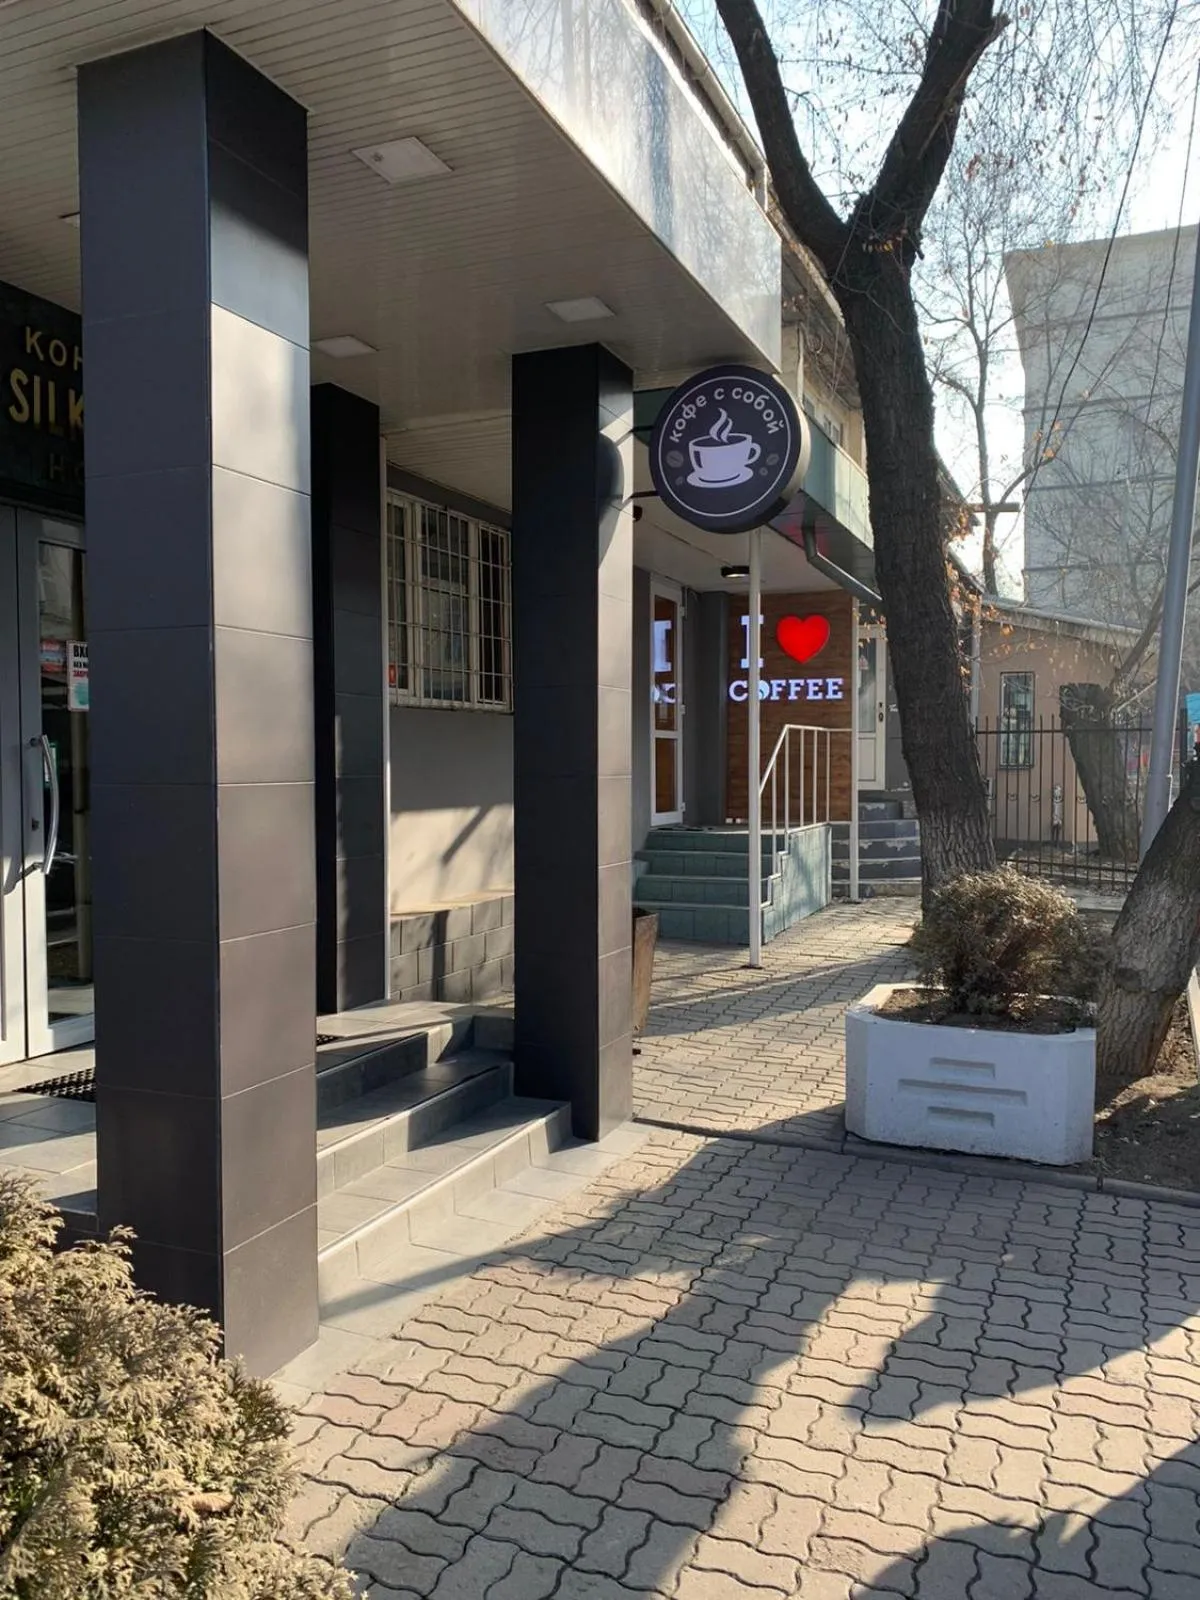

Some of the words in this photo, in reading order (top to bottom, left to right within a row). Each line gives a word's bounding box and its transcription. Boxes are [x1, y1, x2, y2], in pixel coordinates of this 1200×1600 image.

[670, 395, 707, 443] кофе
[714, 387, 725, 400] с
[731, 387, 785, 435] собой
[740, 614, 764, 669] I
